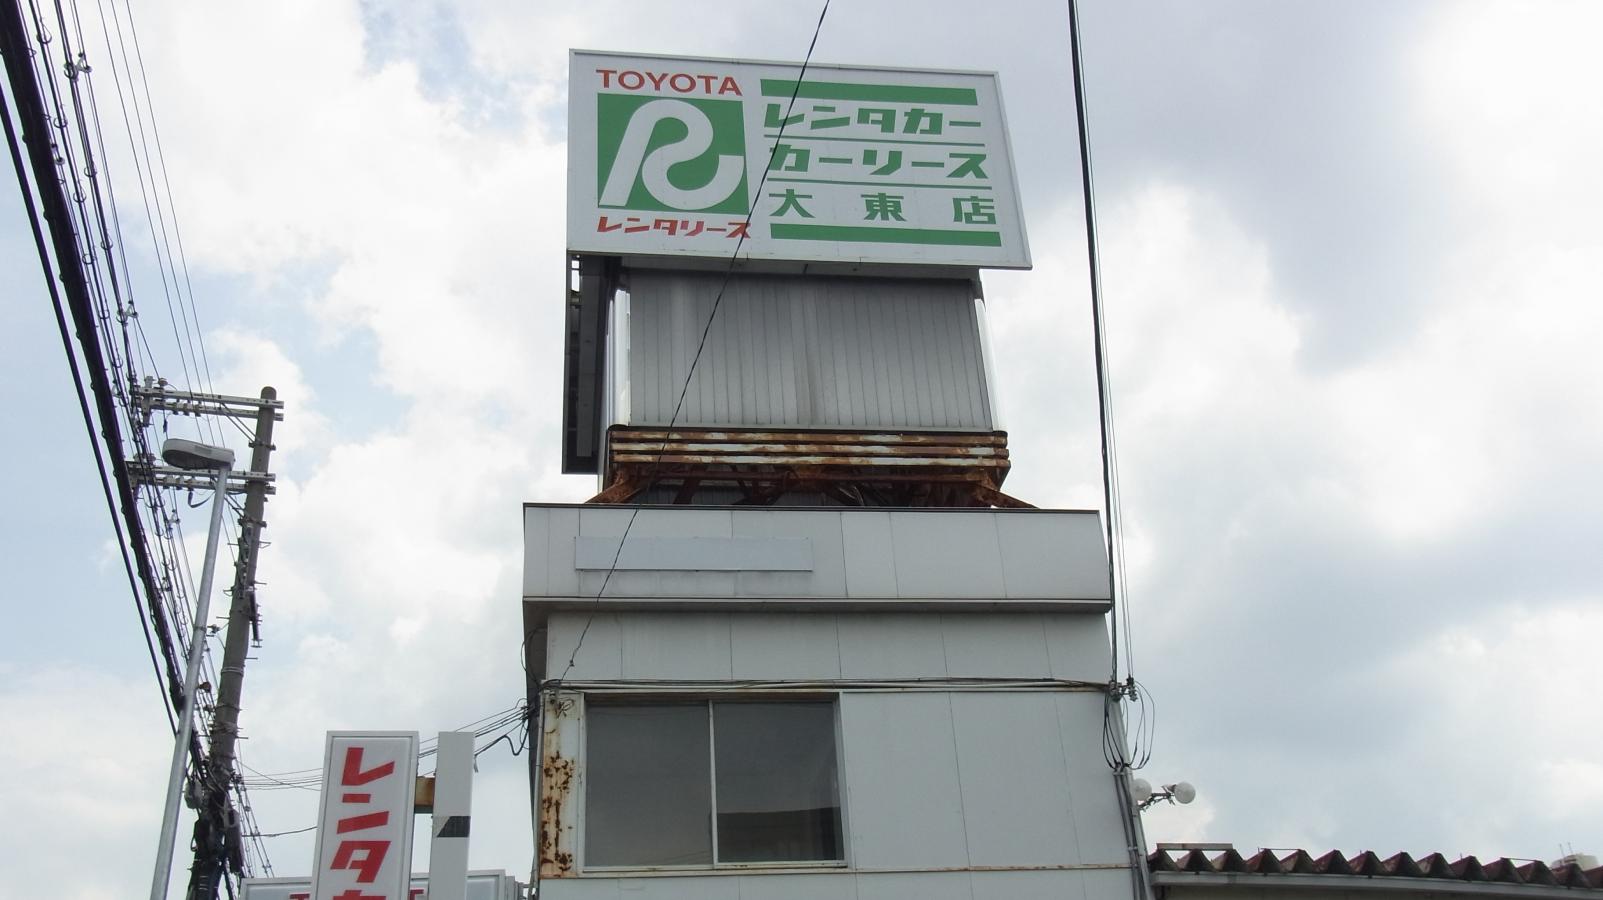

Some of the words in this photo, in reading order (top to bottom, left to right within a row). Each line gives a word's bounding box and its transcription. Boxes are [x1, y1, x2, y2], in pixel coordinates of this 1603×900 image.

[596, 69, 743, 97] TOYOTA
[763, 103, 982, 135] レンタカー
[768, 144, 989, 179] カーリース
[597, 216, 751, 239] レンタリース
